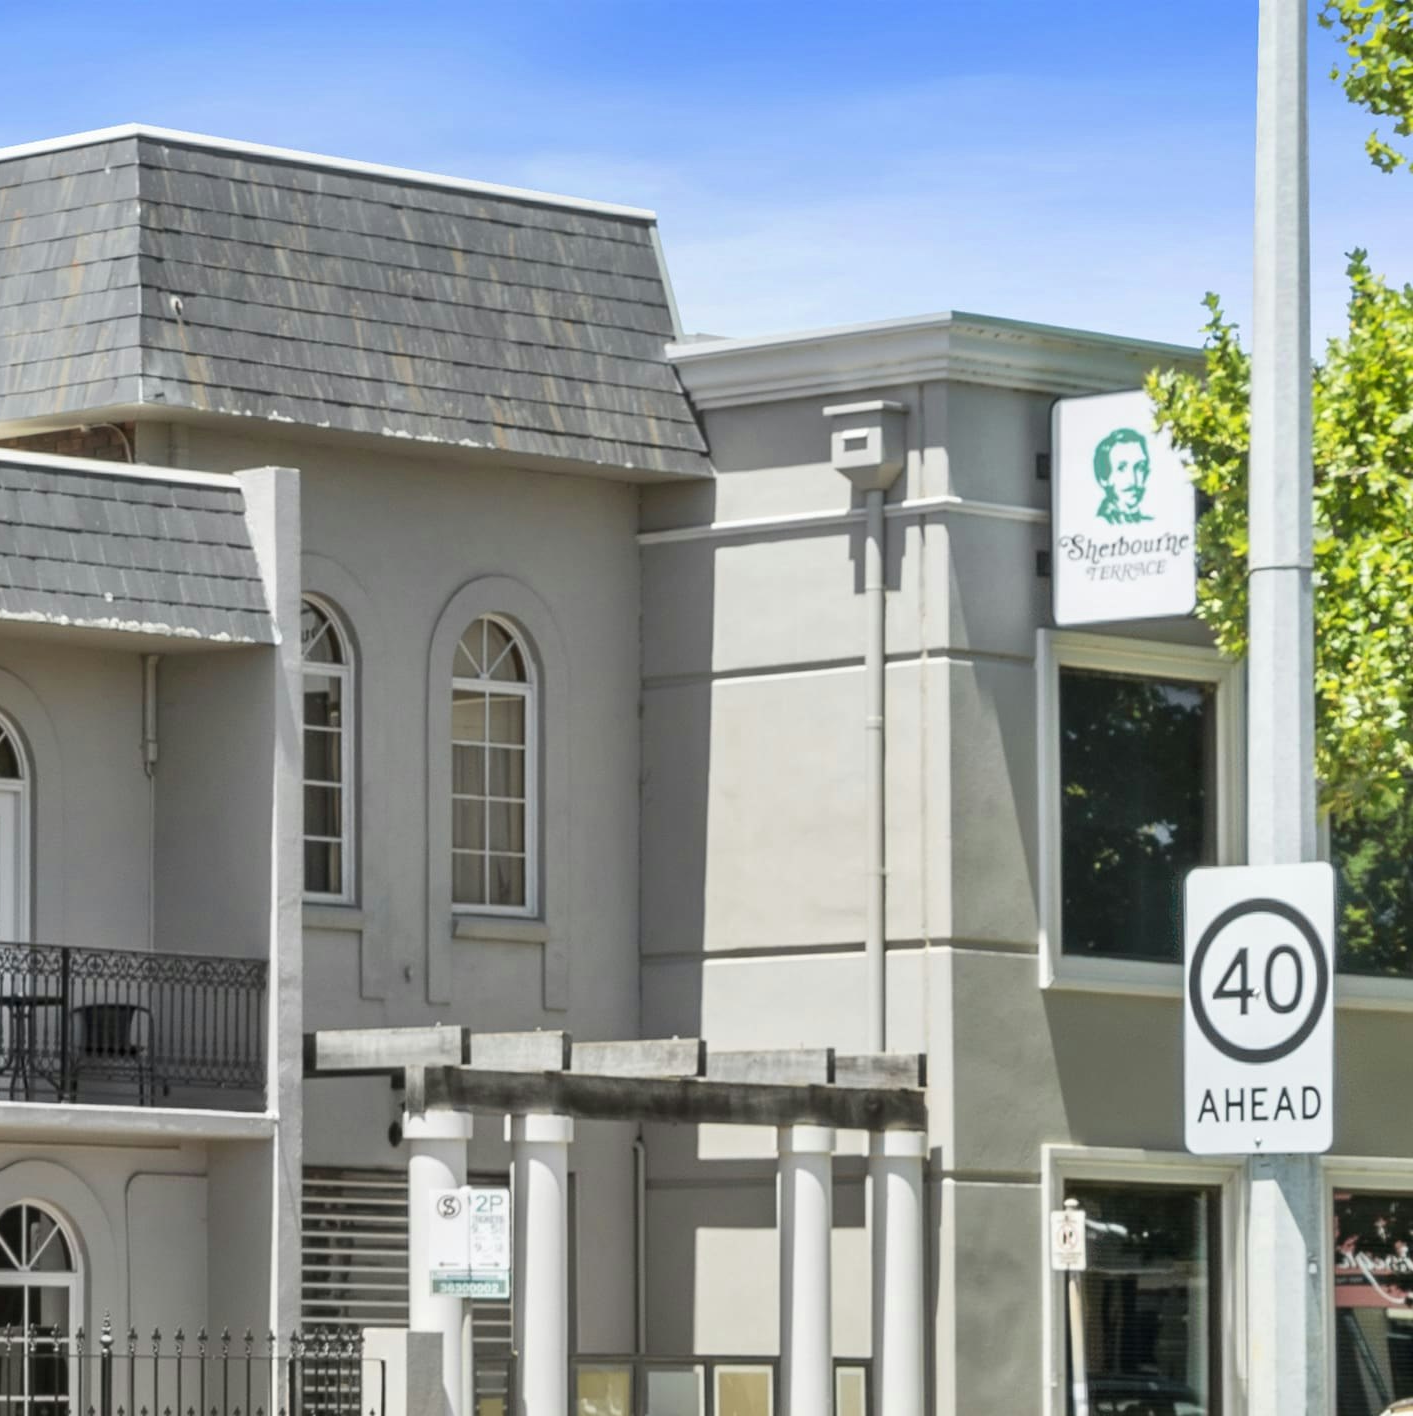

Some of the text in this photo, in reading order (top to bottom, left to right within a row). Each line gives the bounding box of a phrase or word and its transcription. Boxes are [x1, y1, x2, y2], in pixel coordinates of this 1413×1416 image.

[1060, 532, 1189, 564] Sherbourne
[1086, 560, 1167, 581] TERRACE
[1212, 944, 1303, 1015] 40
[1197, 1086, 1322, 1123] AHEAD
[476, 1194, 504, 1213] 2P
